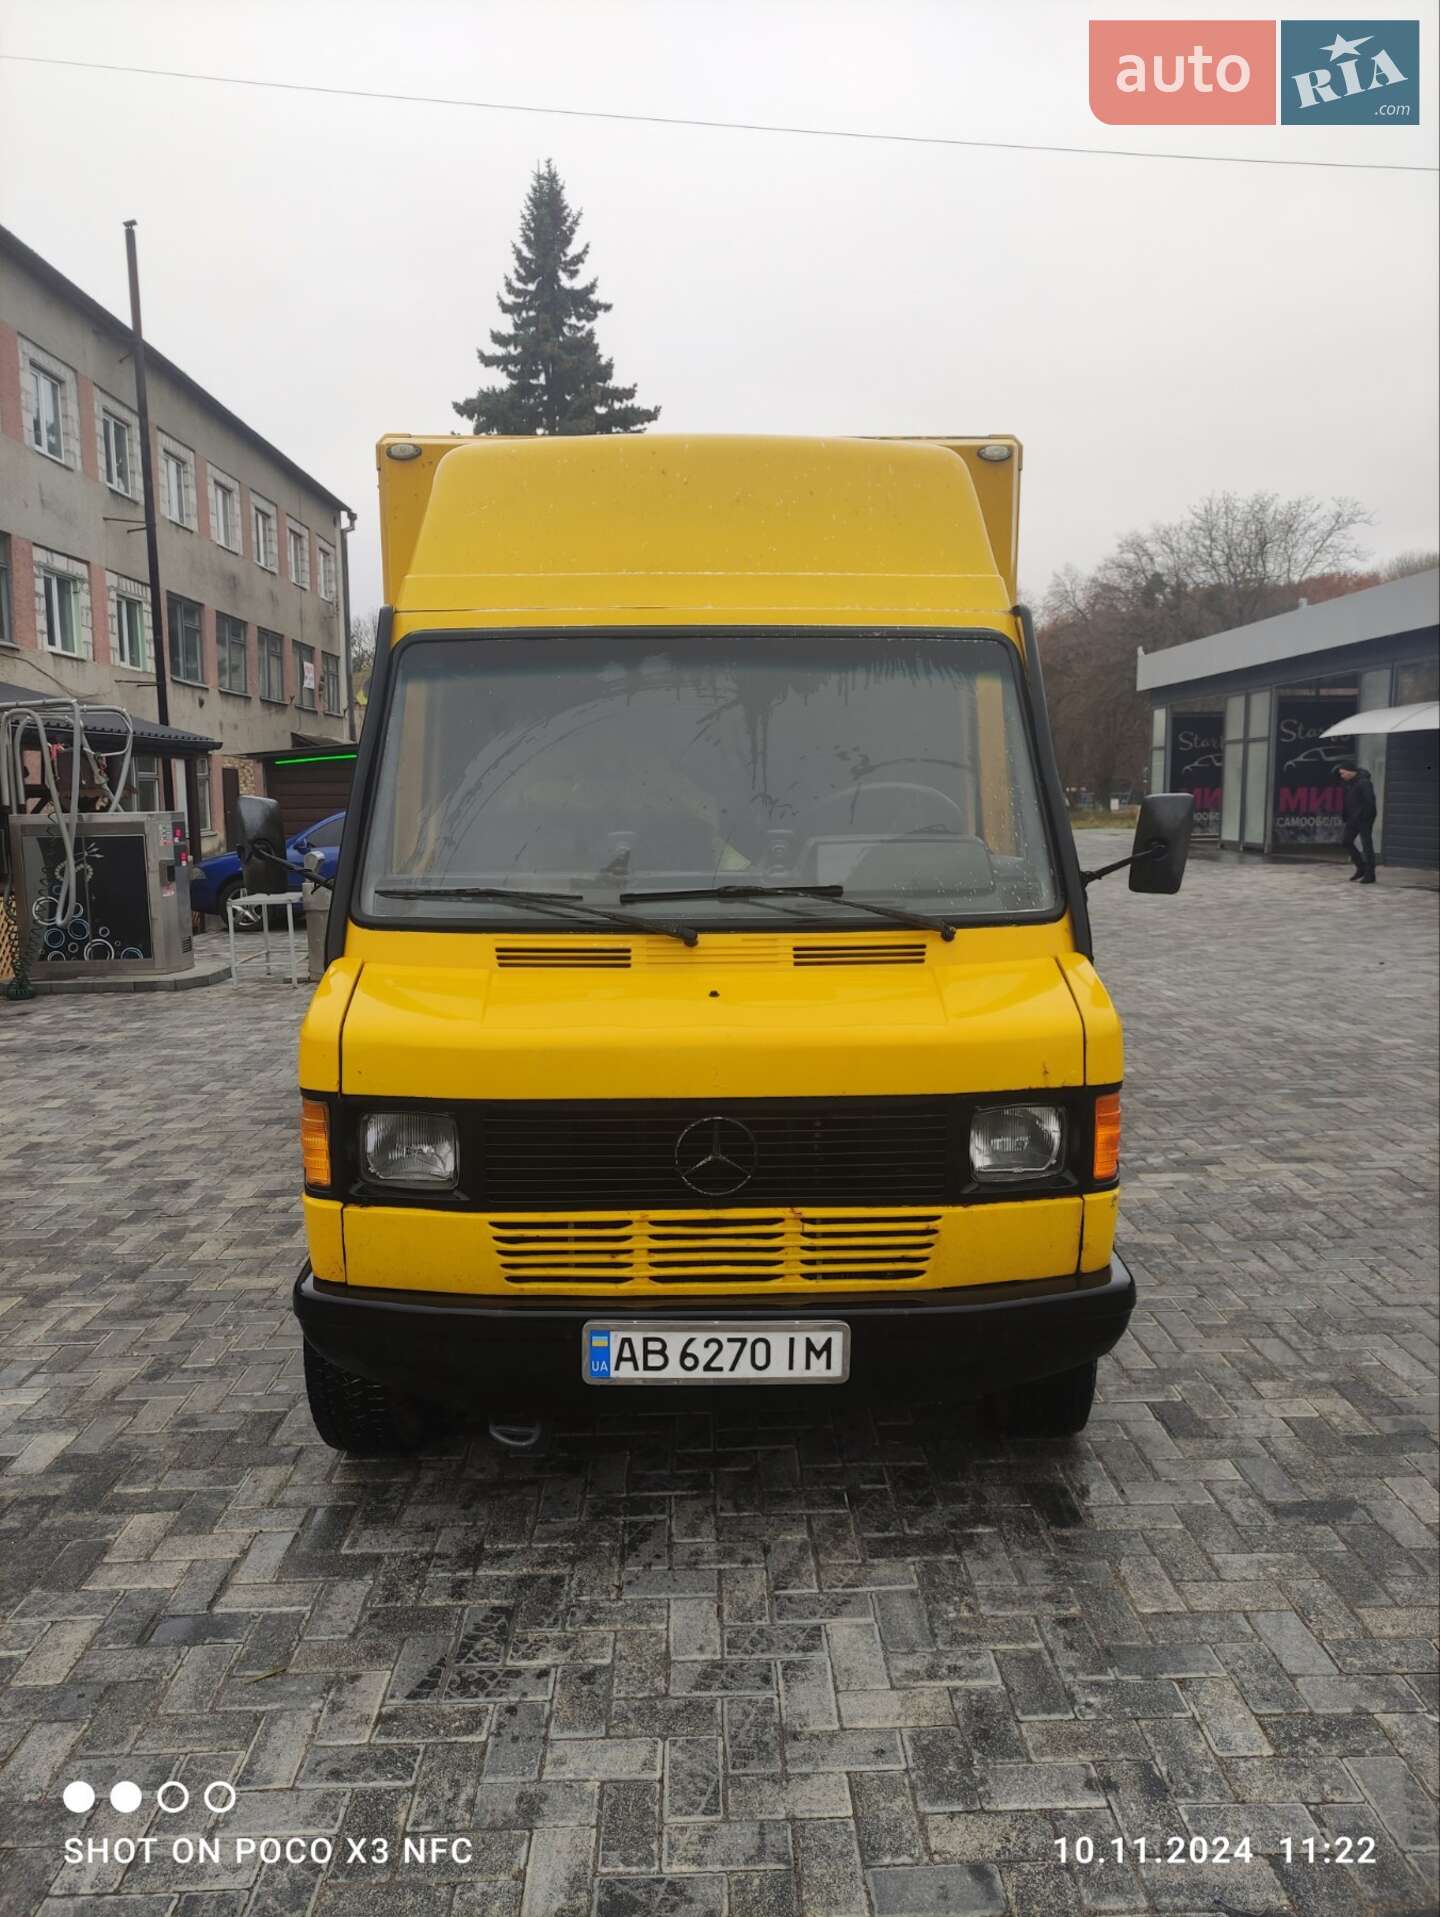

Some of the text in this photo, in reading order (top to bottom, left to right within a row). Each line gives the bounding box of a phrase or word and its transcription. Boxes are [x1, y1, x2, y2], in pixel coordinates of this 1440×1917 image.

[614, 1336, 832, 1372] AB 6270 IM
[591, 1361, 609, 1373] UA
